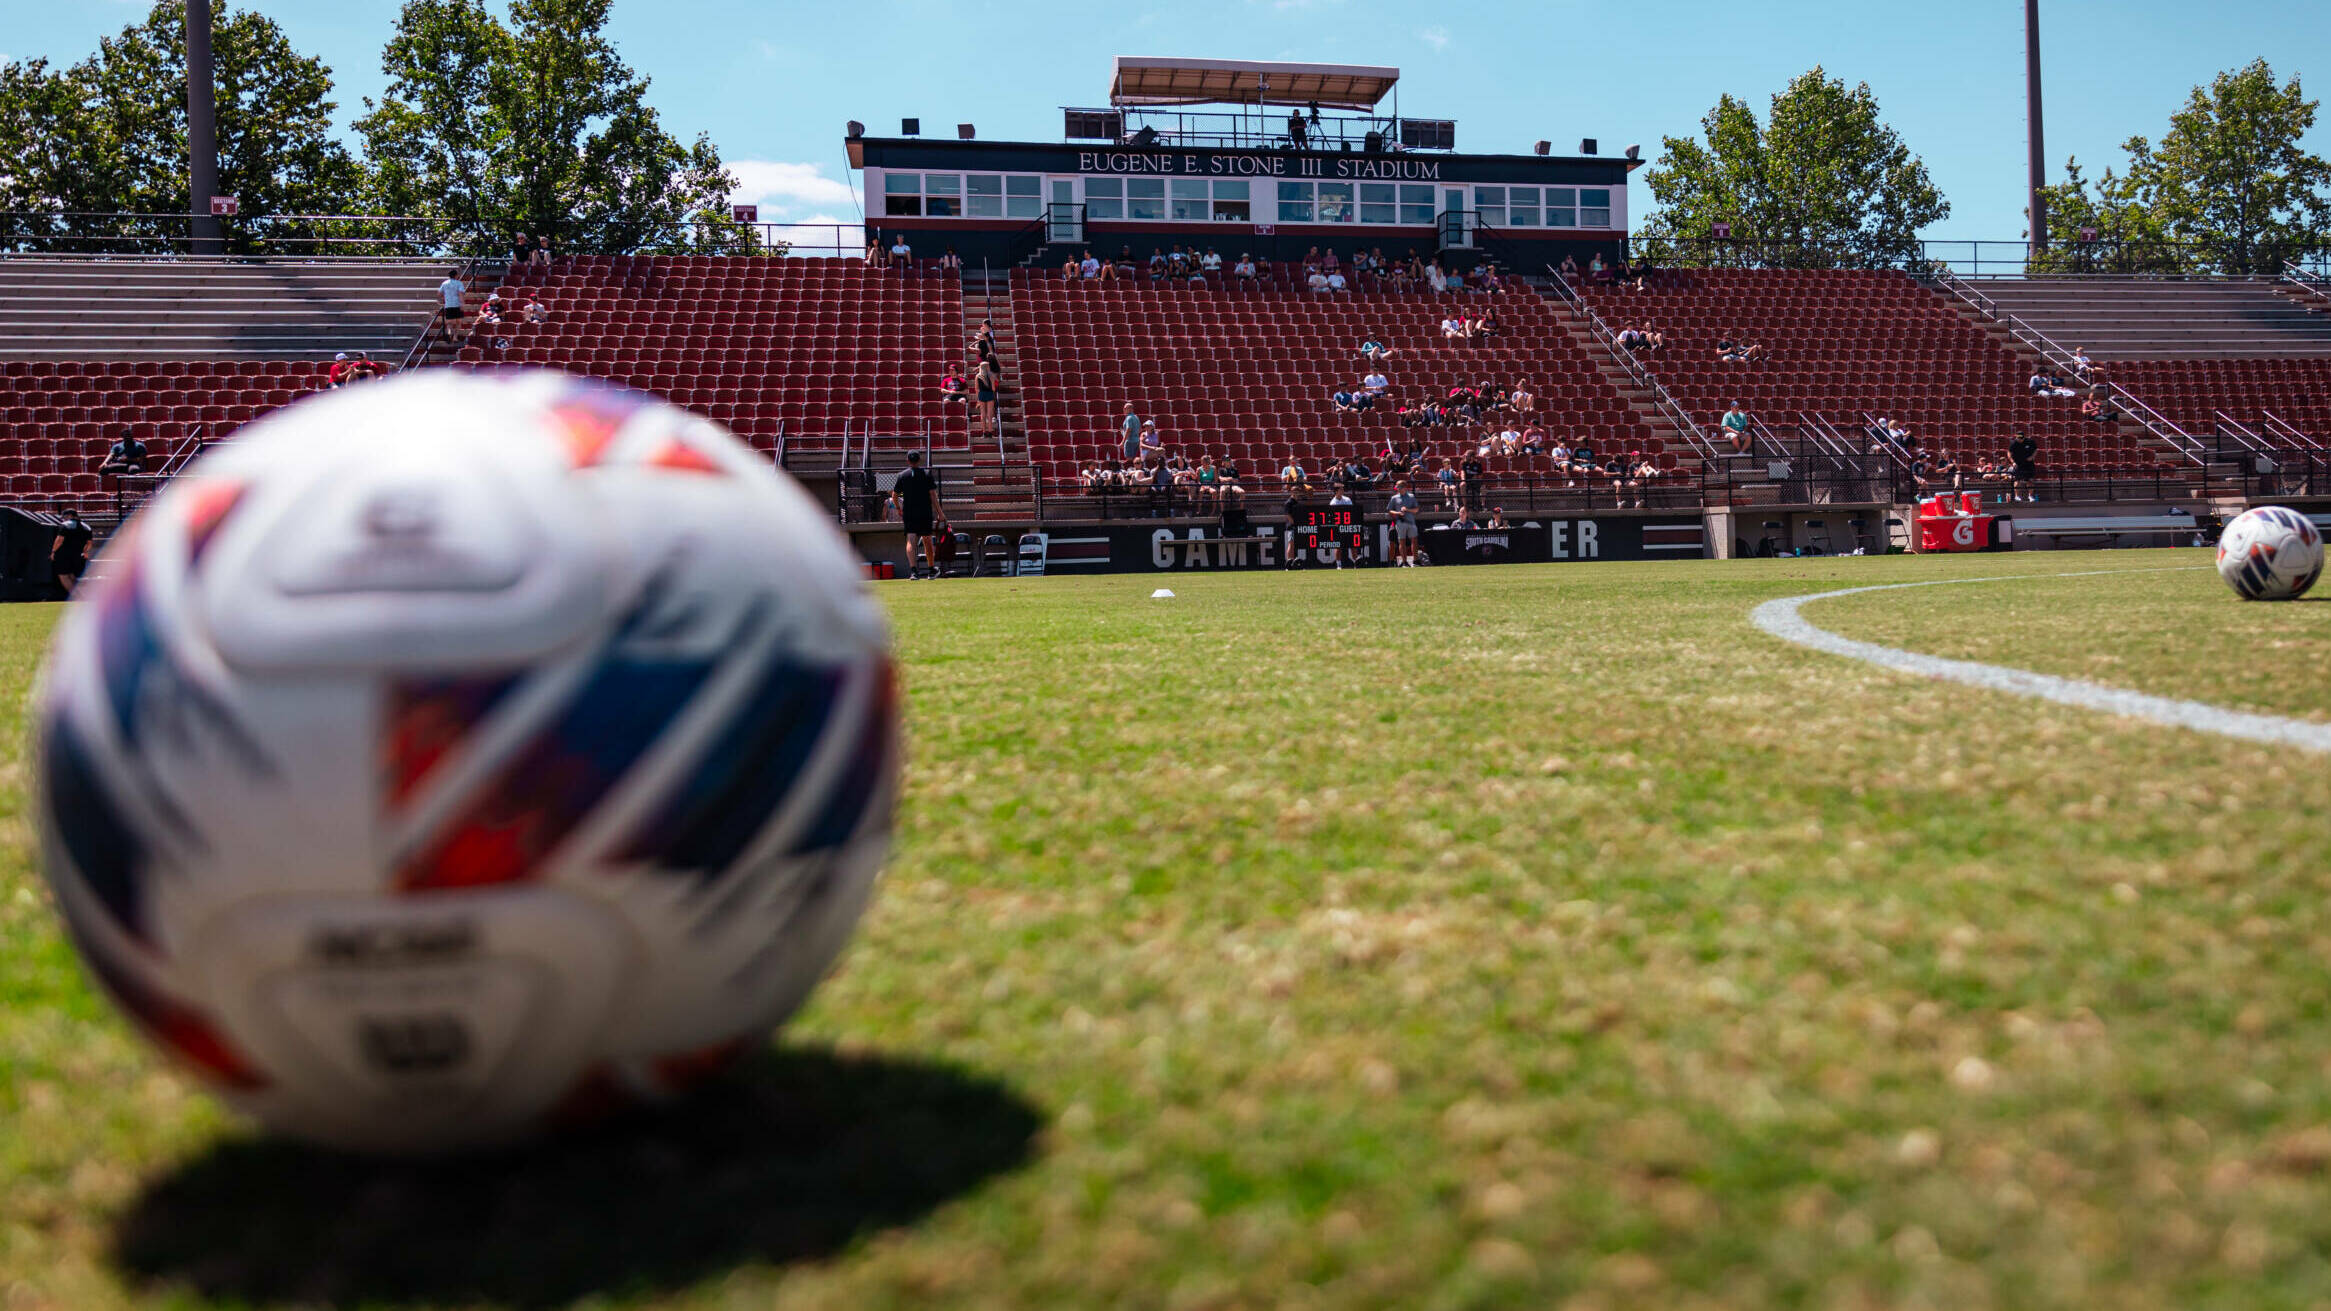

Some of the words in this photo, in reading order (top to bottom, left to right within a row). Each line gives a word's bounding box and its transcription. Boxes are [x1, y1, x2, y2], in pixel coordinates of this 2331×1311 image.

[1079, 152, 1174, 172] EUGENE
[1184, 155, 1203, 173] E.
[1210, 155, 1286, 175] STONE
[1300, 158, 1323, 176] III
[1336, 159, 1440, 179] STADIUM
[221, 204, 227, 212] 3
[1308, 512, 1351, 525] 37:38
[1298, 526, 1318, 534] HOME
[1330, 528, 1334, 542] 1
[1340, 525, 1362, 533] GUEST
[1953, 520, 1974, 545] G
[1309, 535, 1317, 548] 0
[1353, 534, 1361, 547] 0
